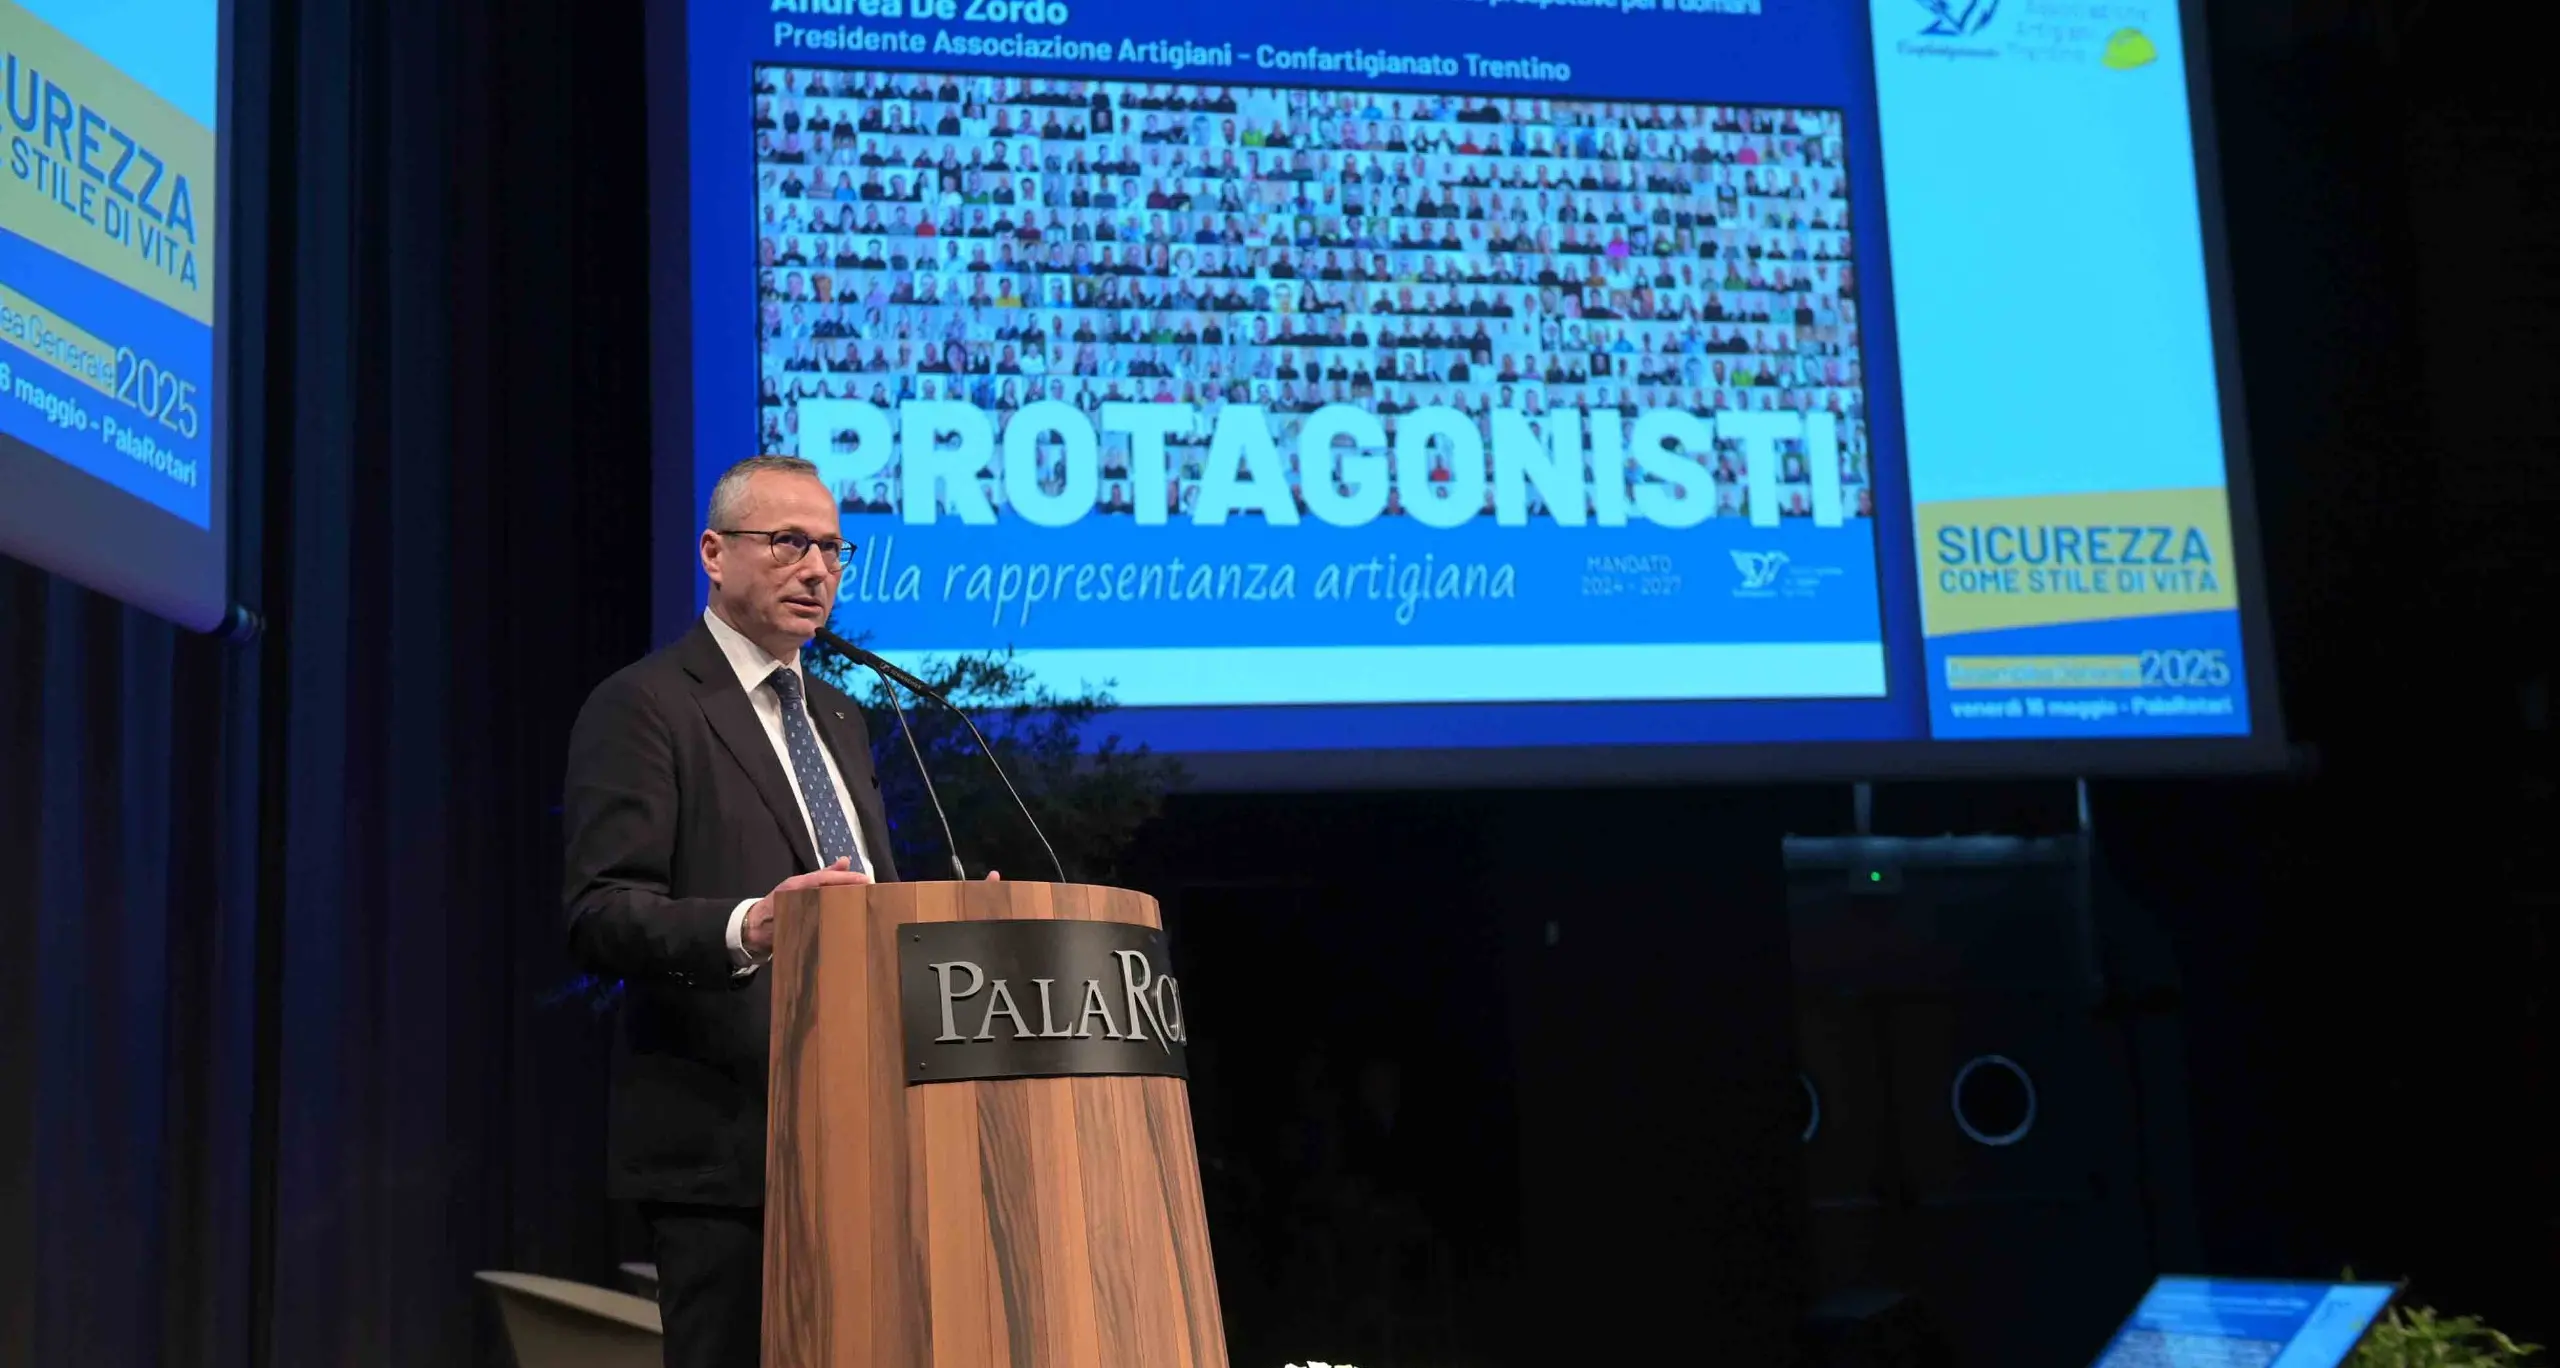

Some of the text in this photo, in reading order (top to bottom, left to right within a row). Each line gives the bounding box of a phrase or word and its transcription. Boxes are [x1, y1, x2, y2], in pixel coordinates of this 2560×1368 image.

[911, 0, 956, 20] De
[963, 0, 1068, 25] Zordo
[773, 22, 927, 52] Presidente
[933, 29, 1112, 61] Associazione
[1118, 38, 1232, 70] Artigiani
[1256, 44, 1458, 78] Confartigianato
[1463, 53, 1571, 82] Trentino
[0, 52, 196, 245] UREZZA
[11, 136, 197, 291] STILE DI VITA
[116, 346, 198, 439] 2025
[15, 376, 88, 430] maggio
[102, 415, 197, 488] PalaRotari
[797, 399, 1843, 528] PROTAGONISTI
[837, 533, 1516, 627] ella rappresentanza artigiana
[1587, 555, 1672, 574] MANDATO
[1936, 525, 2213, 565] SICUREZZA
[1939, 569, 2220, 593] COME STILE DI VITA
[2140, 649, 2232, 688] 2025
